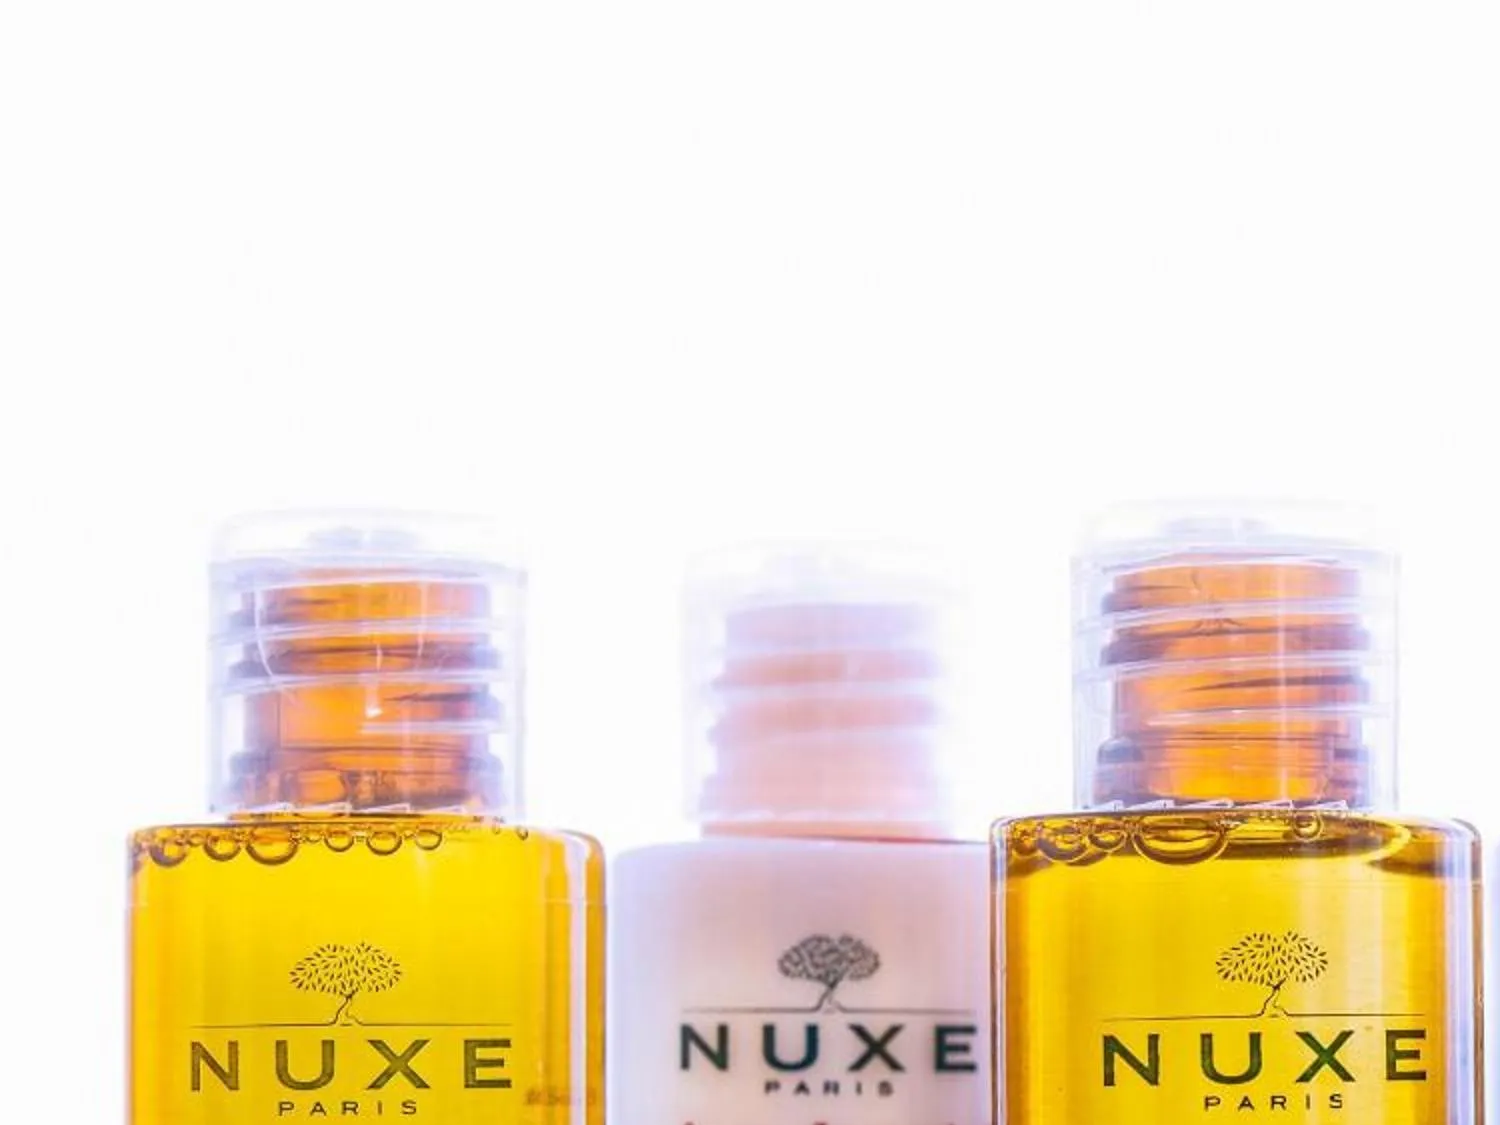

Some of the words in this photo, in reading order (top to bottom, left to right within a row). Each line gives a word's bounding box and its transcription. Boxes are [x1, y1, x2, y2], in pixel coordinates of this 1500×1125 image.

[190, 1038, 512, 1091] NUXE
[680, 1024, 977, 1073] NUXE
[1102, 1029, 1427, 1087] NUXE
[764, 1081, 894, 1096] PARIS
[1205, 1094, 1343, 1110] PARIS
[278, 1100, 417, 1116] PARIS
